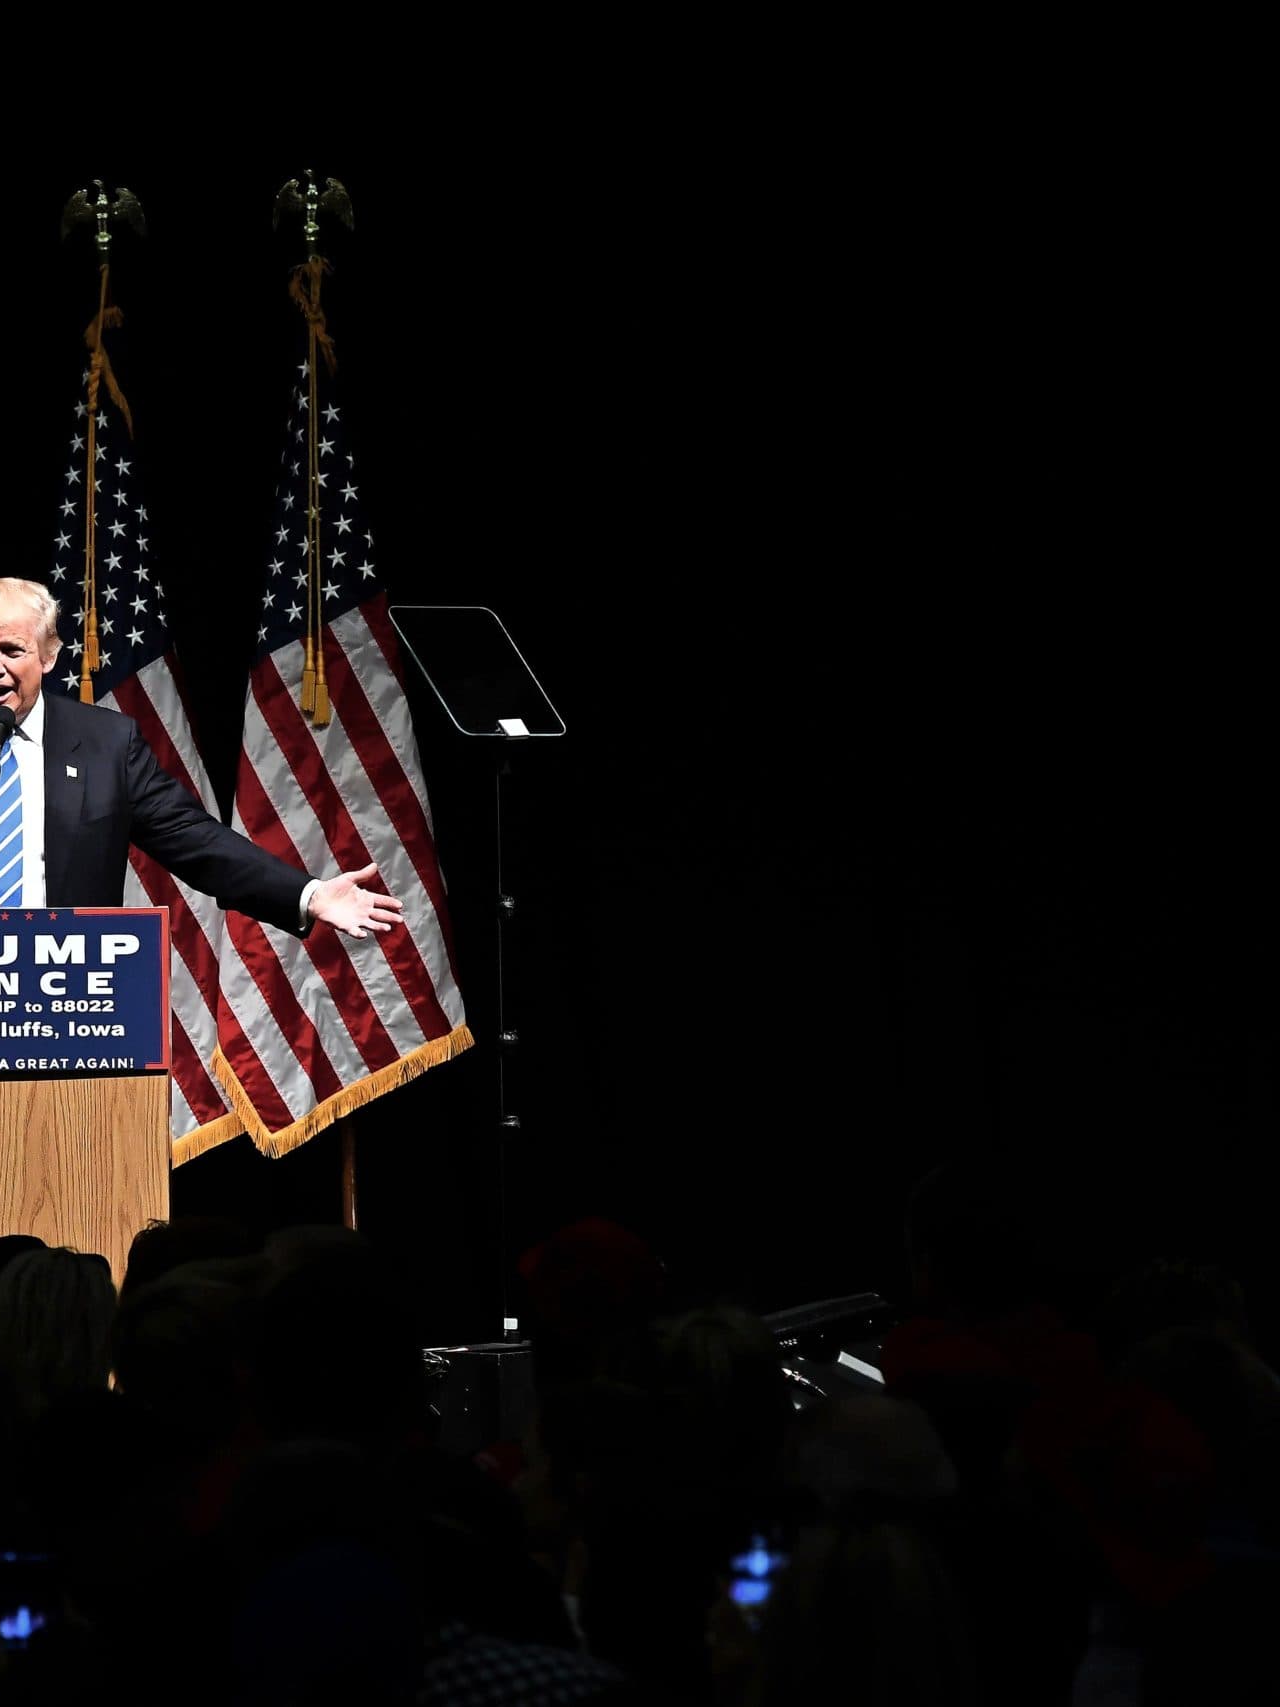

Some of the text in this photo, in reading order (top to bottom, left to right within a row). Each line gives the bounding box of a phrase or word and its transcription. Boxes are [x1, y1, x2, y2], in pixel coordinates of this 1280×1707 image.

[24, 1001, 43, 1013] to
[50, 999, 115, 1013] 88022
[68, 1021, 125, 1037] Iowa
[15, 1058, 70, 1070] GREAT
[74, 1057, 134, 1069] AGAIN!
